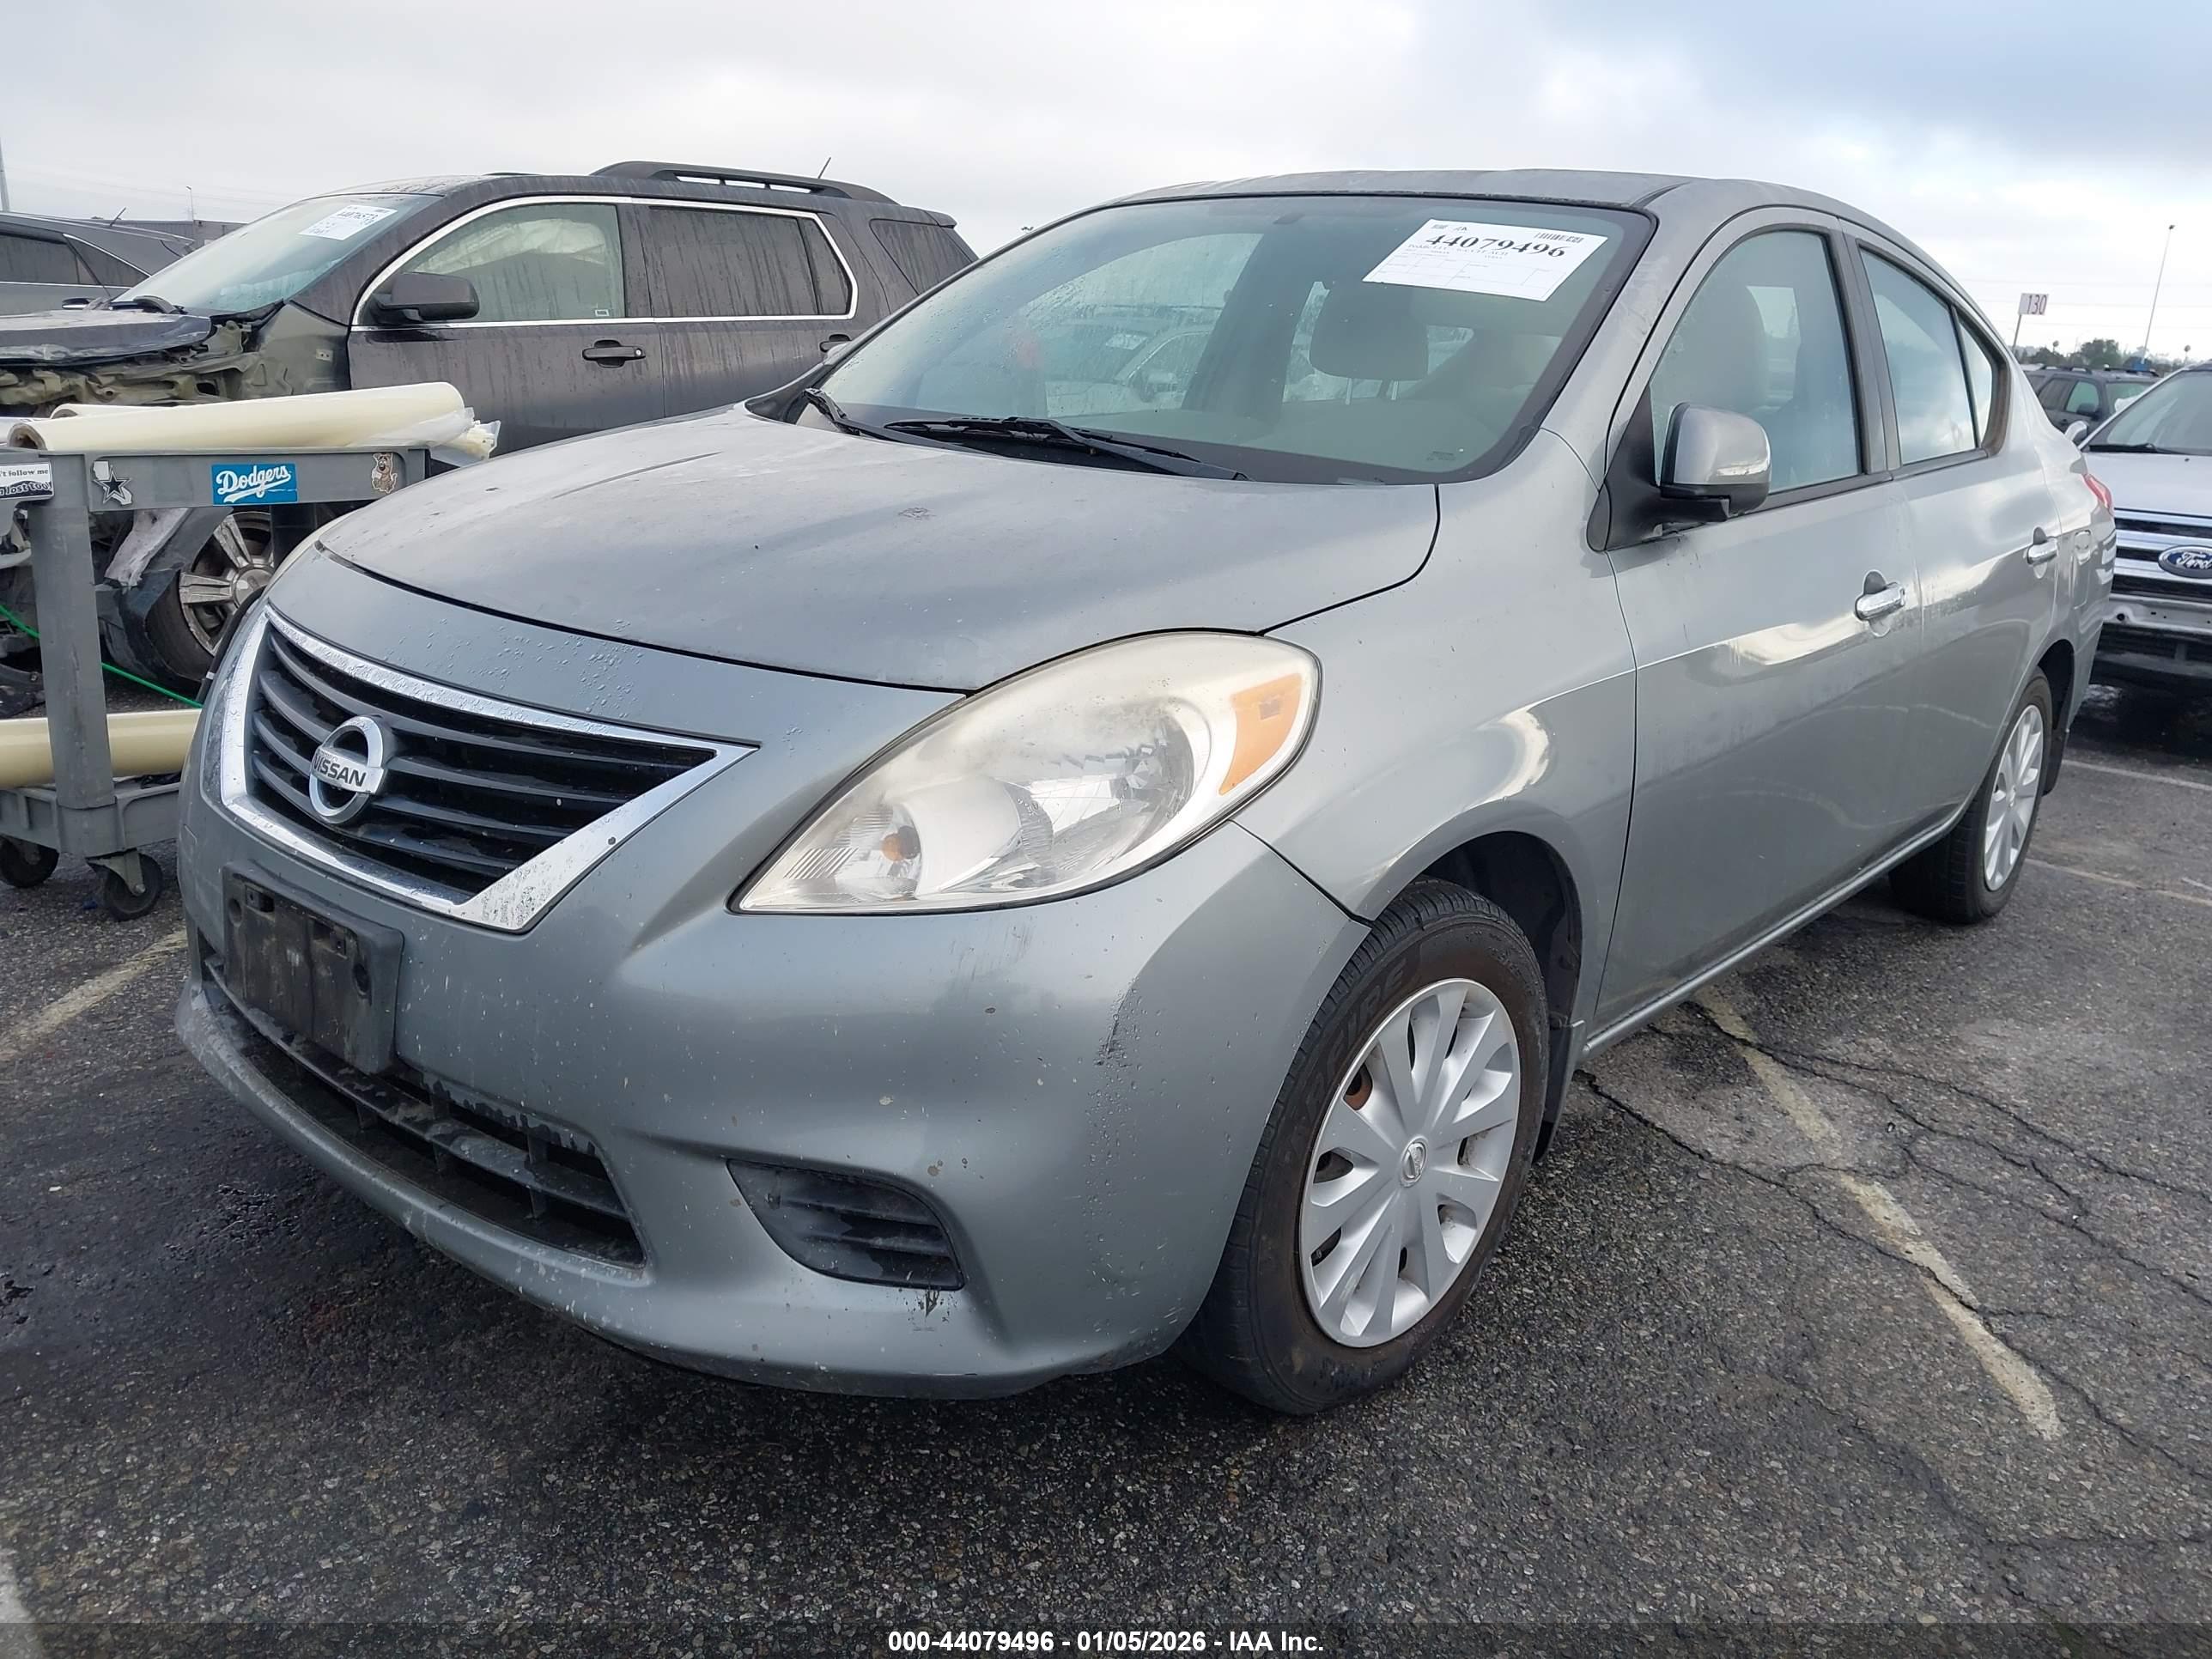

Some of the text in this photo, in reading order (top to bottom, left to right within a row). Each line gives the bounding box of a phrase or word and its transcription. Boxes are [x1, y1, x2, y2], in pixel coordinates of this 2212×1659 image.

[1425, 234, 1571, 258] 44079496
[2027, 295, 2047, 315] 130
[6, 483, 28, 495] lost
[216, 465, 291, 502] Dodgers
[313, 752, 367, 787] NISSAN
